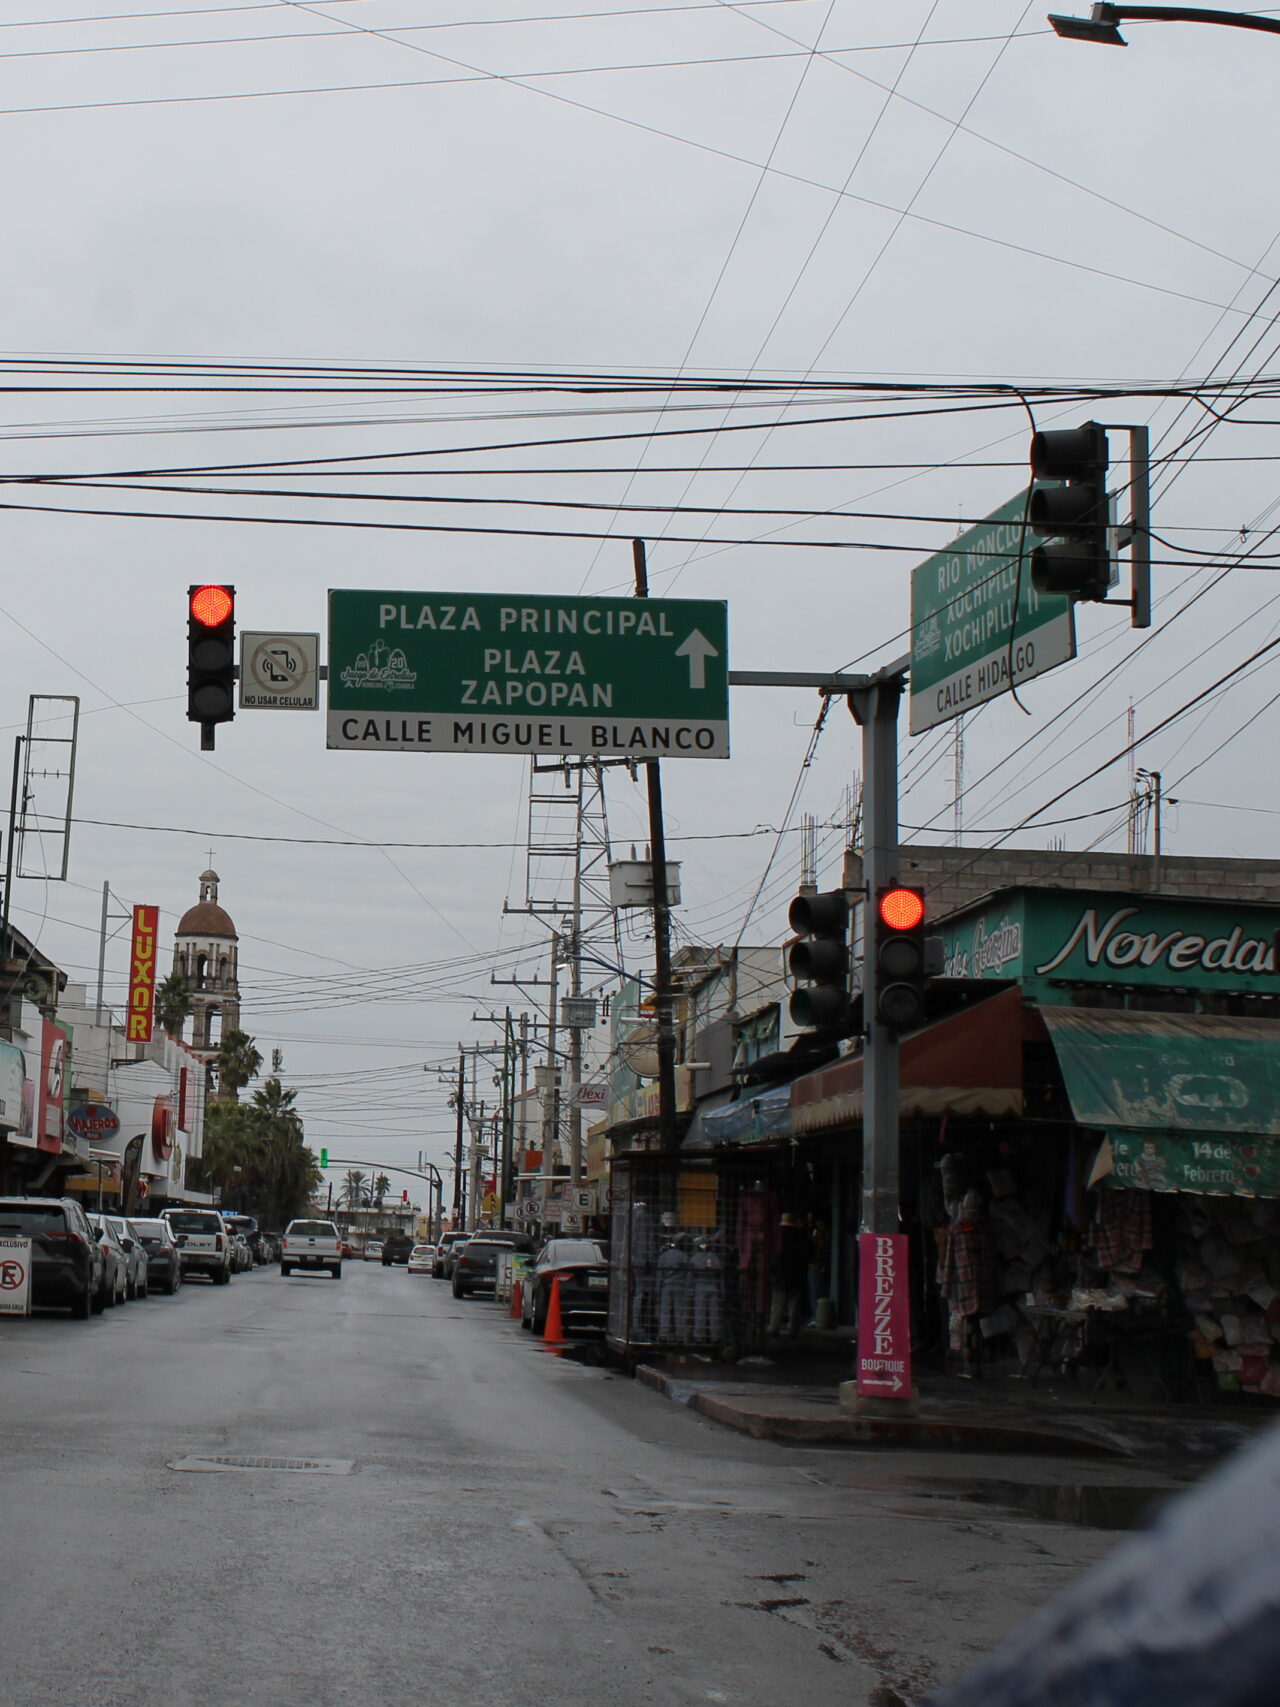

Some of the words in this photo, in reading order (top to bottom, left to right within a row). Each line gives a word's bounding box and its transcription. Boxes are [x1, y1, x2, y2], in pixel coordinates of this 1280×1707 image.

[967, 508, 1034, 573] MONCLOV
[379, 604, 482, 632] PLAZA
[499, 607, 674, 637] PRINCIPAL
[391, 657, 404, 669] 20
[484, 648, 587, 675] PLAZA
[340, 665, 368, 688] Juego
[380, 667, 417, 681] Estrellas
[244, 695, 256, 705] NO
[257, 695, 278, 706] USAR
[279, 696, 313, 707] CELULAR
[461, 679, 613, 708] ZAPOPAN
[936, 674, 972, 714] CALLE
[341, 718, 433, 743] CALLE
[453, 721, 573, 747] MIGUEL
[591, 725, 715, 750] BLANCO
[129, 909, 153, 1039] LUXOR
[576, 1087, 606, 1100] flexi
[1191, 1141, 1212, 1159] 14
[1213, 1143, 1233, 1160] de
[1184, 1164, 1235, 1183] Febrero
[873, 1237, 896, 1355] BREZZE
[861, 1358, 905, 1373] BOUTIQUE
